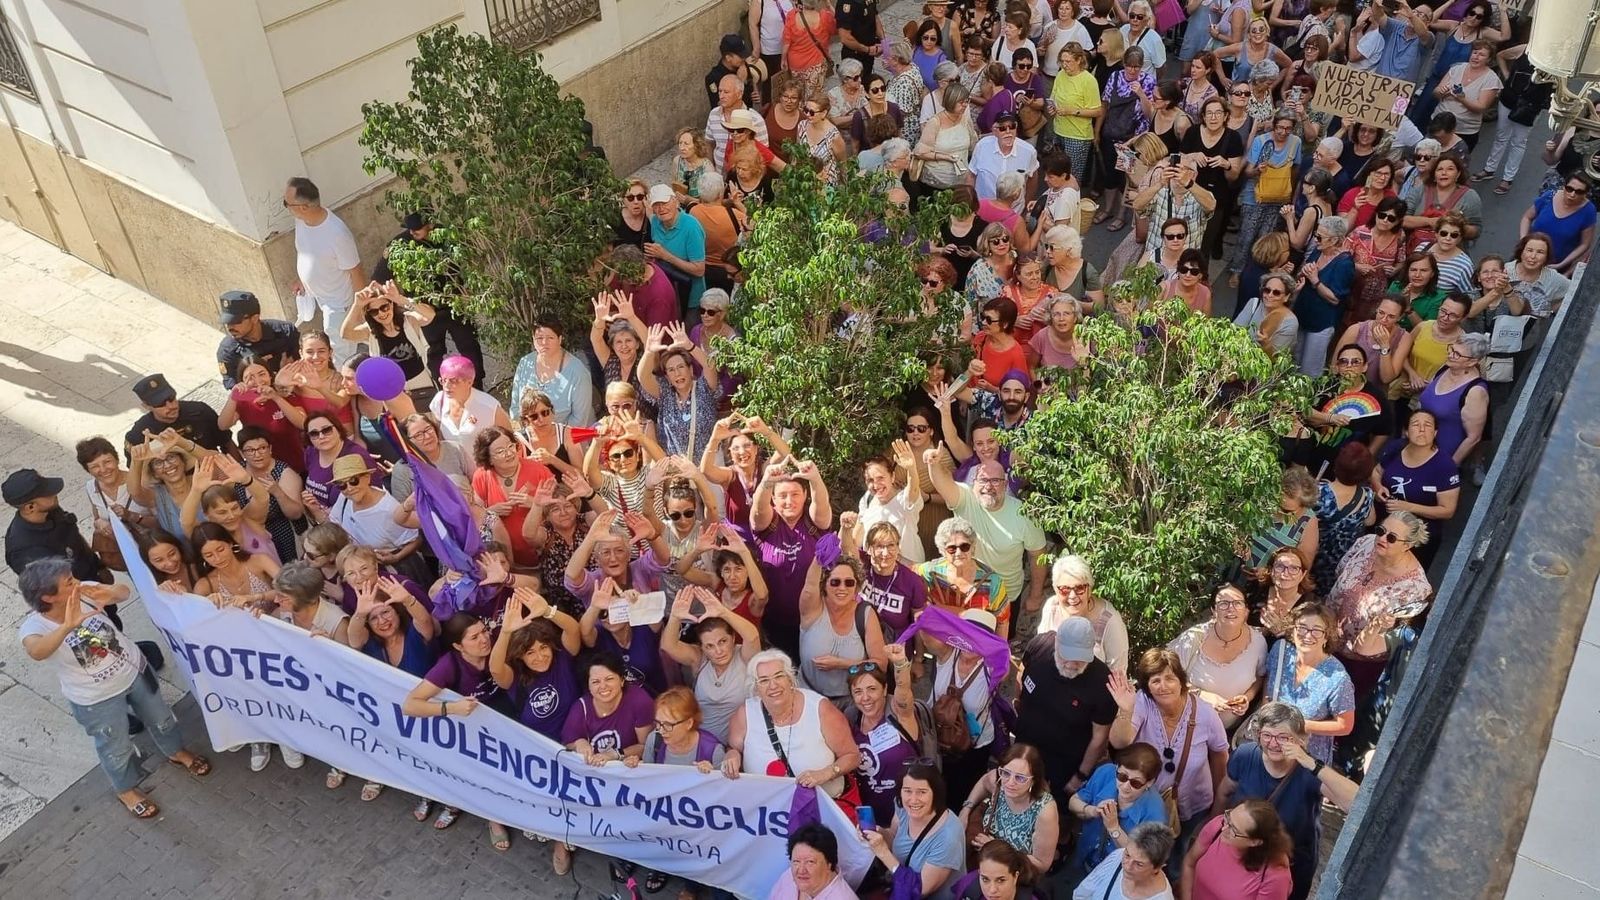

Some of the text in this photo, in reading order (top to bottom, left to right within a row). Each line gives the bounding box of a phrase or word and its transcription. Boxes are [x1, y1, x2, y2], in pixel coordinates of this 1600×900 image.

[1324, 66, 1414, 99] NUESTRAS
[1325, 81, 1376, 104] VIDAS
[1316, 94, 1404, 128] IMPORTAN
[181, 638, 310, 692] TOTES
[391, 701, 606, 808] VIOLÈNCIES
